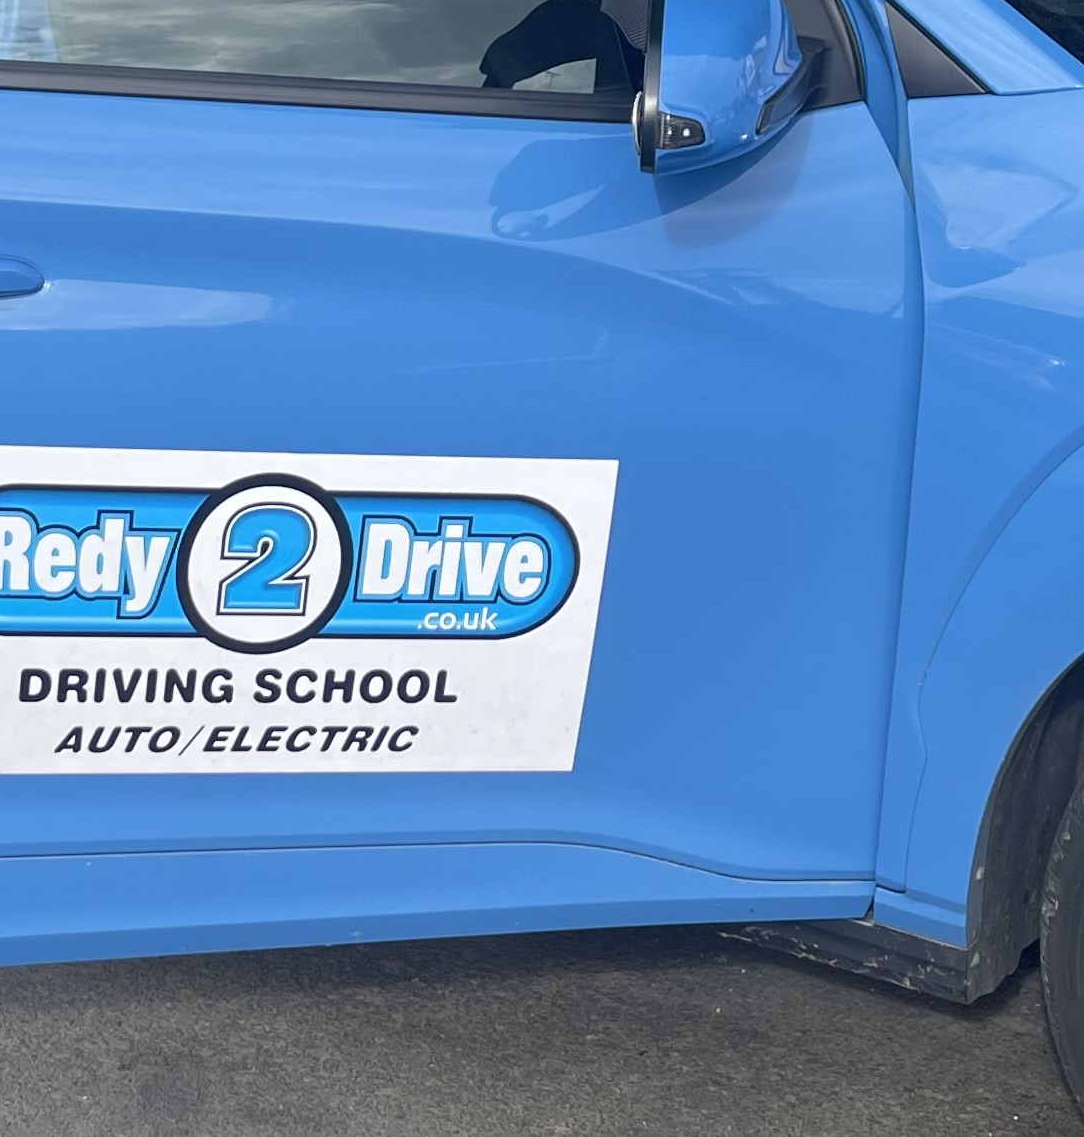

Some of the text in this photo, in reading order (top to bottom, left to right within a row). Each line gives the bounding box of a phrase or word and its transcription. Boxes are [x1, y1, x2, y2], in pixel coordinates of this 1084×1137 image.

[217, 502, 318, 616] 2
[354, 516, 552, 604] Drive
[415, 608, 499, 632] .co.uk
[17, 667, 460, 706] DRIVING SCHOOL
[54, 724, 419, 755] AUTO/ELECTRIC
